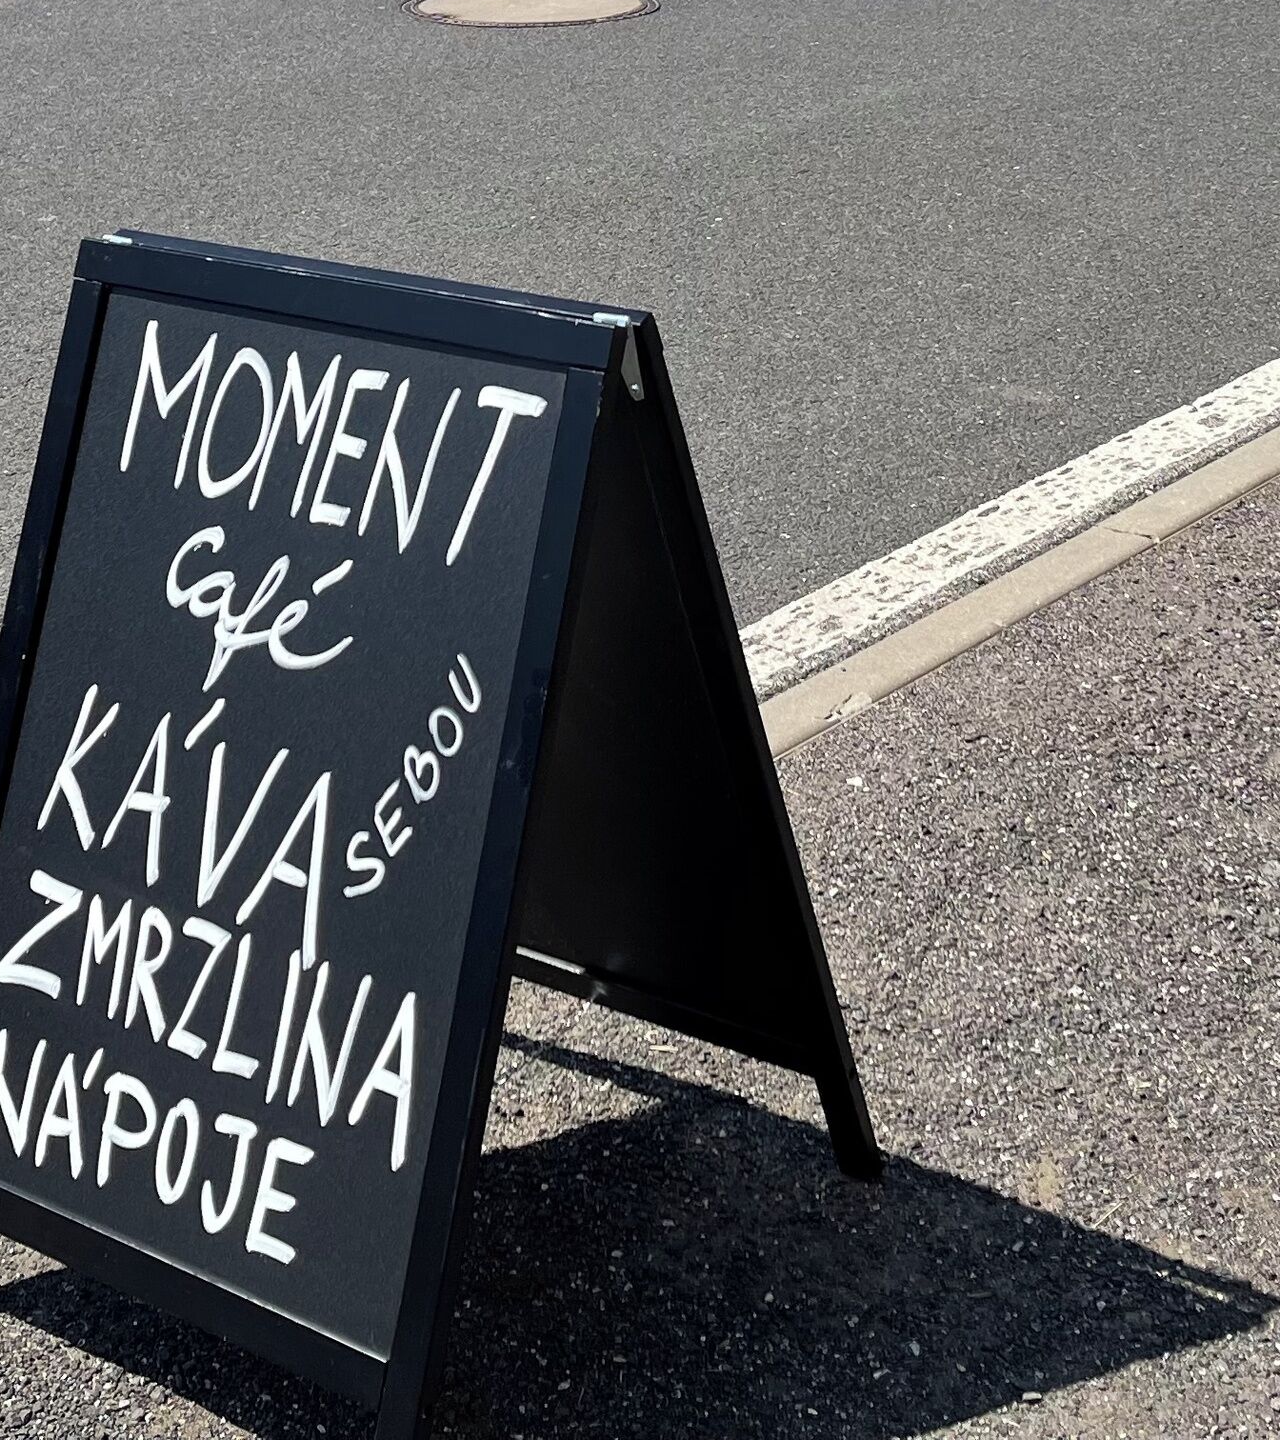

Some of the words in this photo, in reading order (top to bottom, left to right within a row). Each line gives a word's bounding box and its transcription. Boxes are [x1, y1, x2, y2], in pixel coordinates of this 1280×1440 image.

[120, 319, 548, 566] MOMENT
[166, 525, 354, 693] Café
[36, 682, 332, 972] KÁVA
